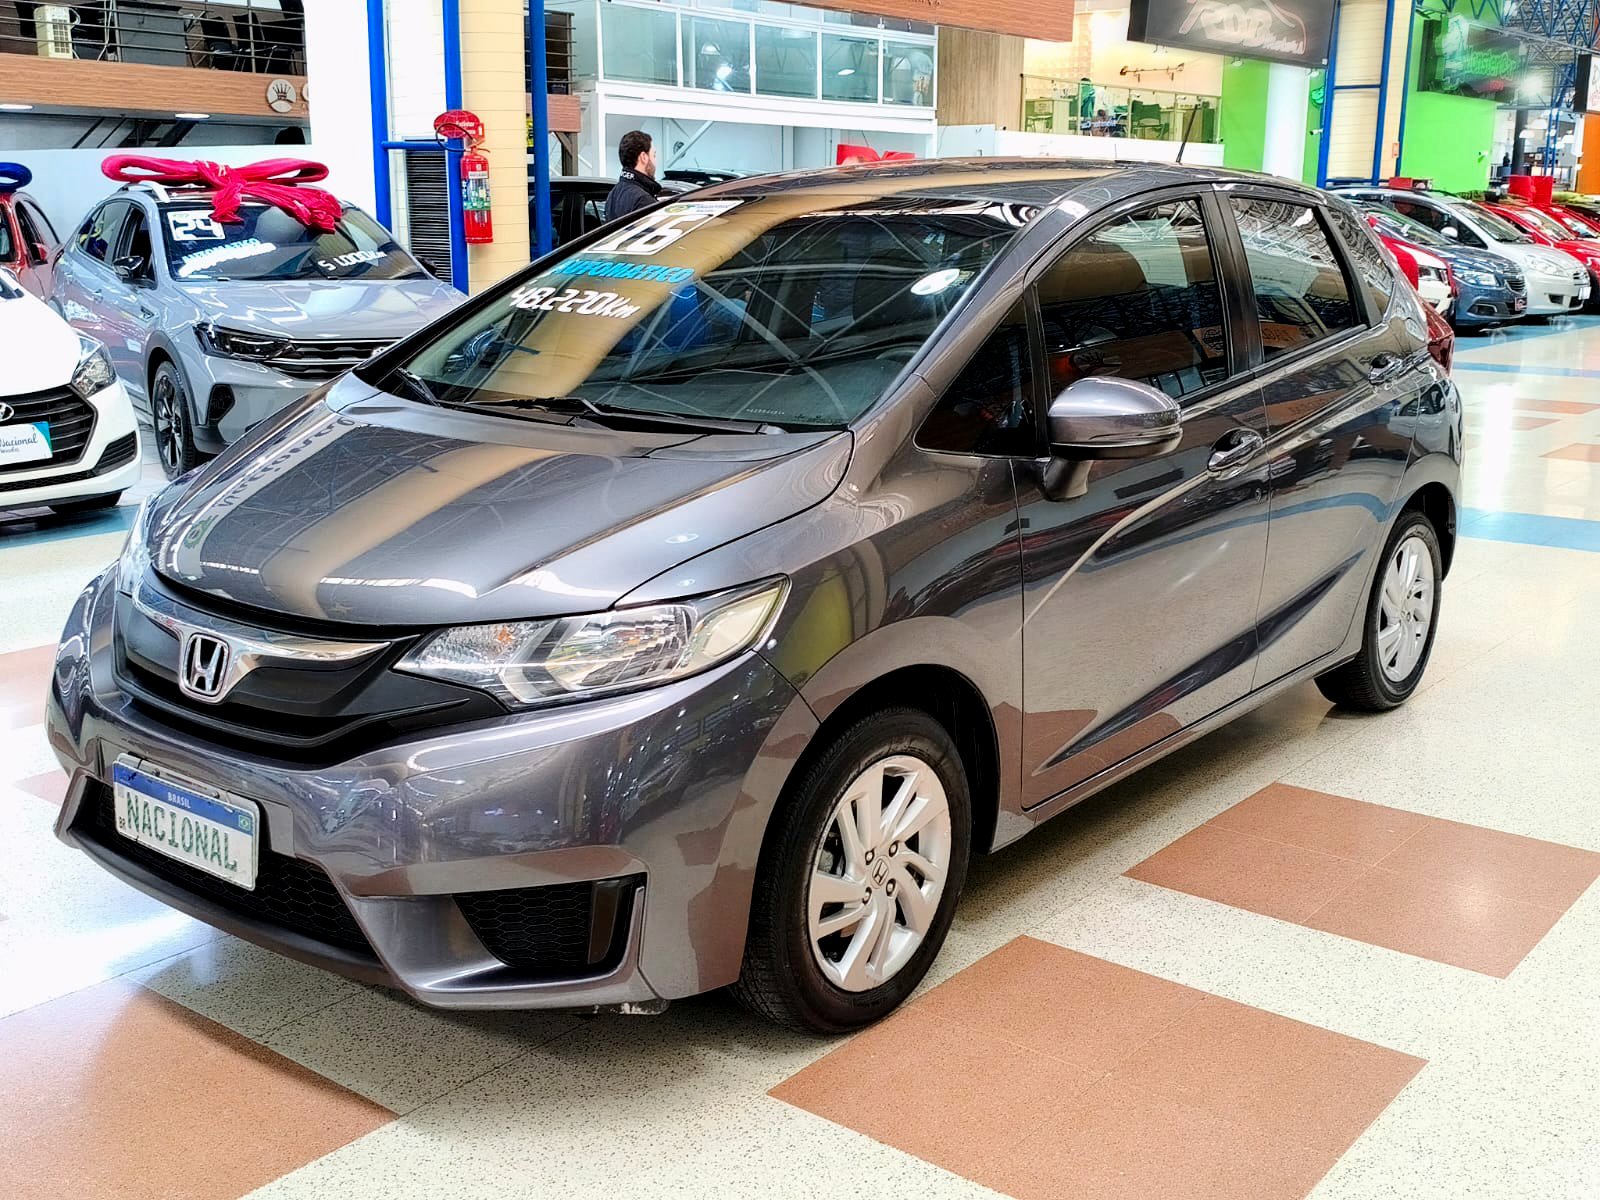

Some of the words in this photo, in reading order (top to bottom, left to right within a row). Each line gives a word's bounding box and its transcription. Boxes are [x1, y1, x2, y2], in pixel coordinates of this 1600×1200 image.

[174, 217, 223, 240] 24
[592, 211, 713, 253] 16
[167, 791, 191, 809] BRASIL
[126, 791, 238, 873] NACIONAL
